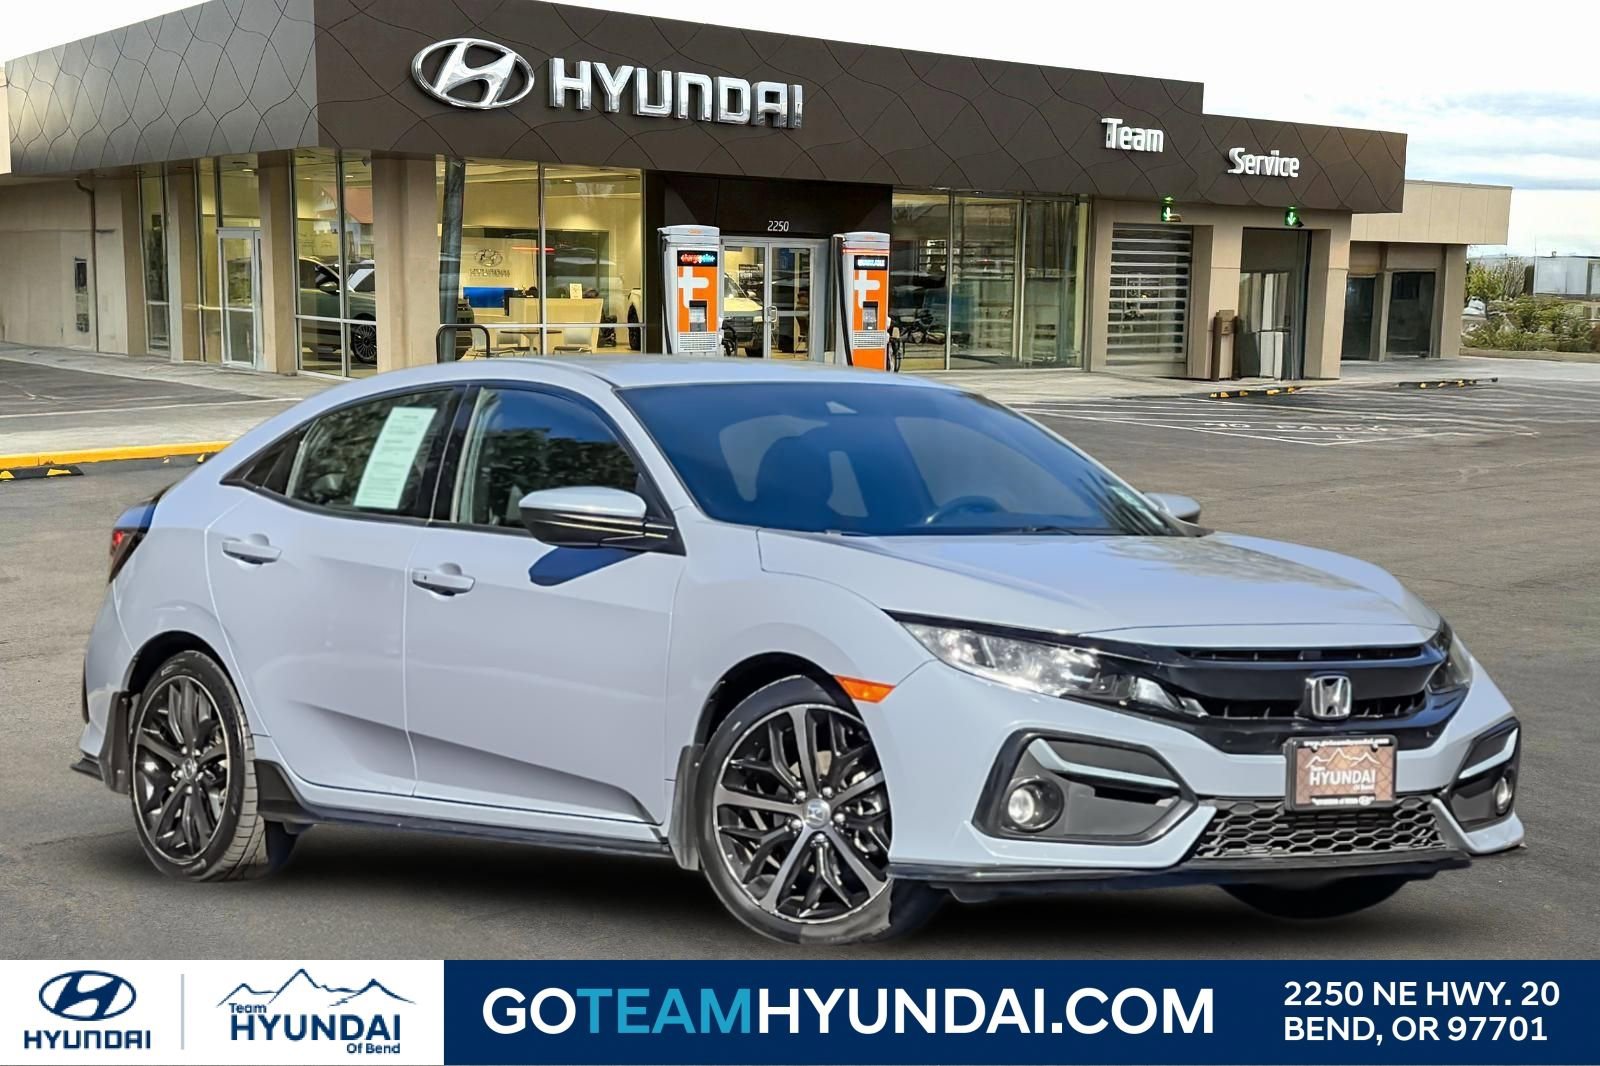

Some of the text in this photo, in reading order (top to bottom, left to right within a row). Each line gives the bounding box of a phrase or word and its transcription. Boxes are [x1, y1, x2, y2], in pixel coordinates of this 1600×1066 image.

[549, 57, 803, 129] HYUNDAI
[1101, 117, 1164, 153] Team
[1227, 147, 1300, 178] Service
[767, 220, 790, 232] 2250
[1309, 768, 1377, 786] HYUNDAI
